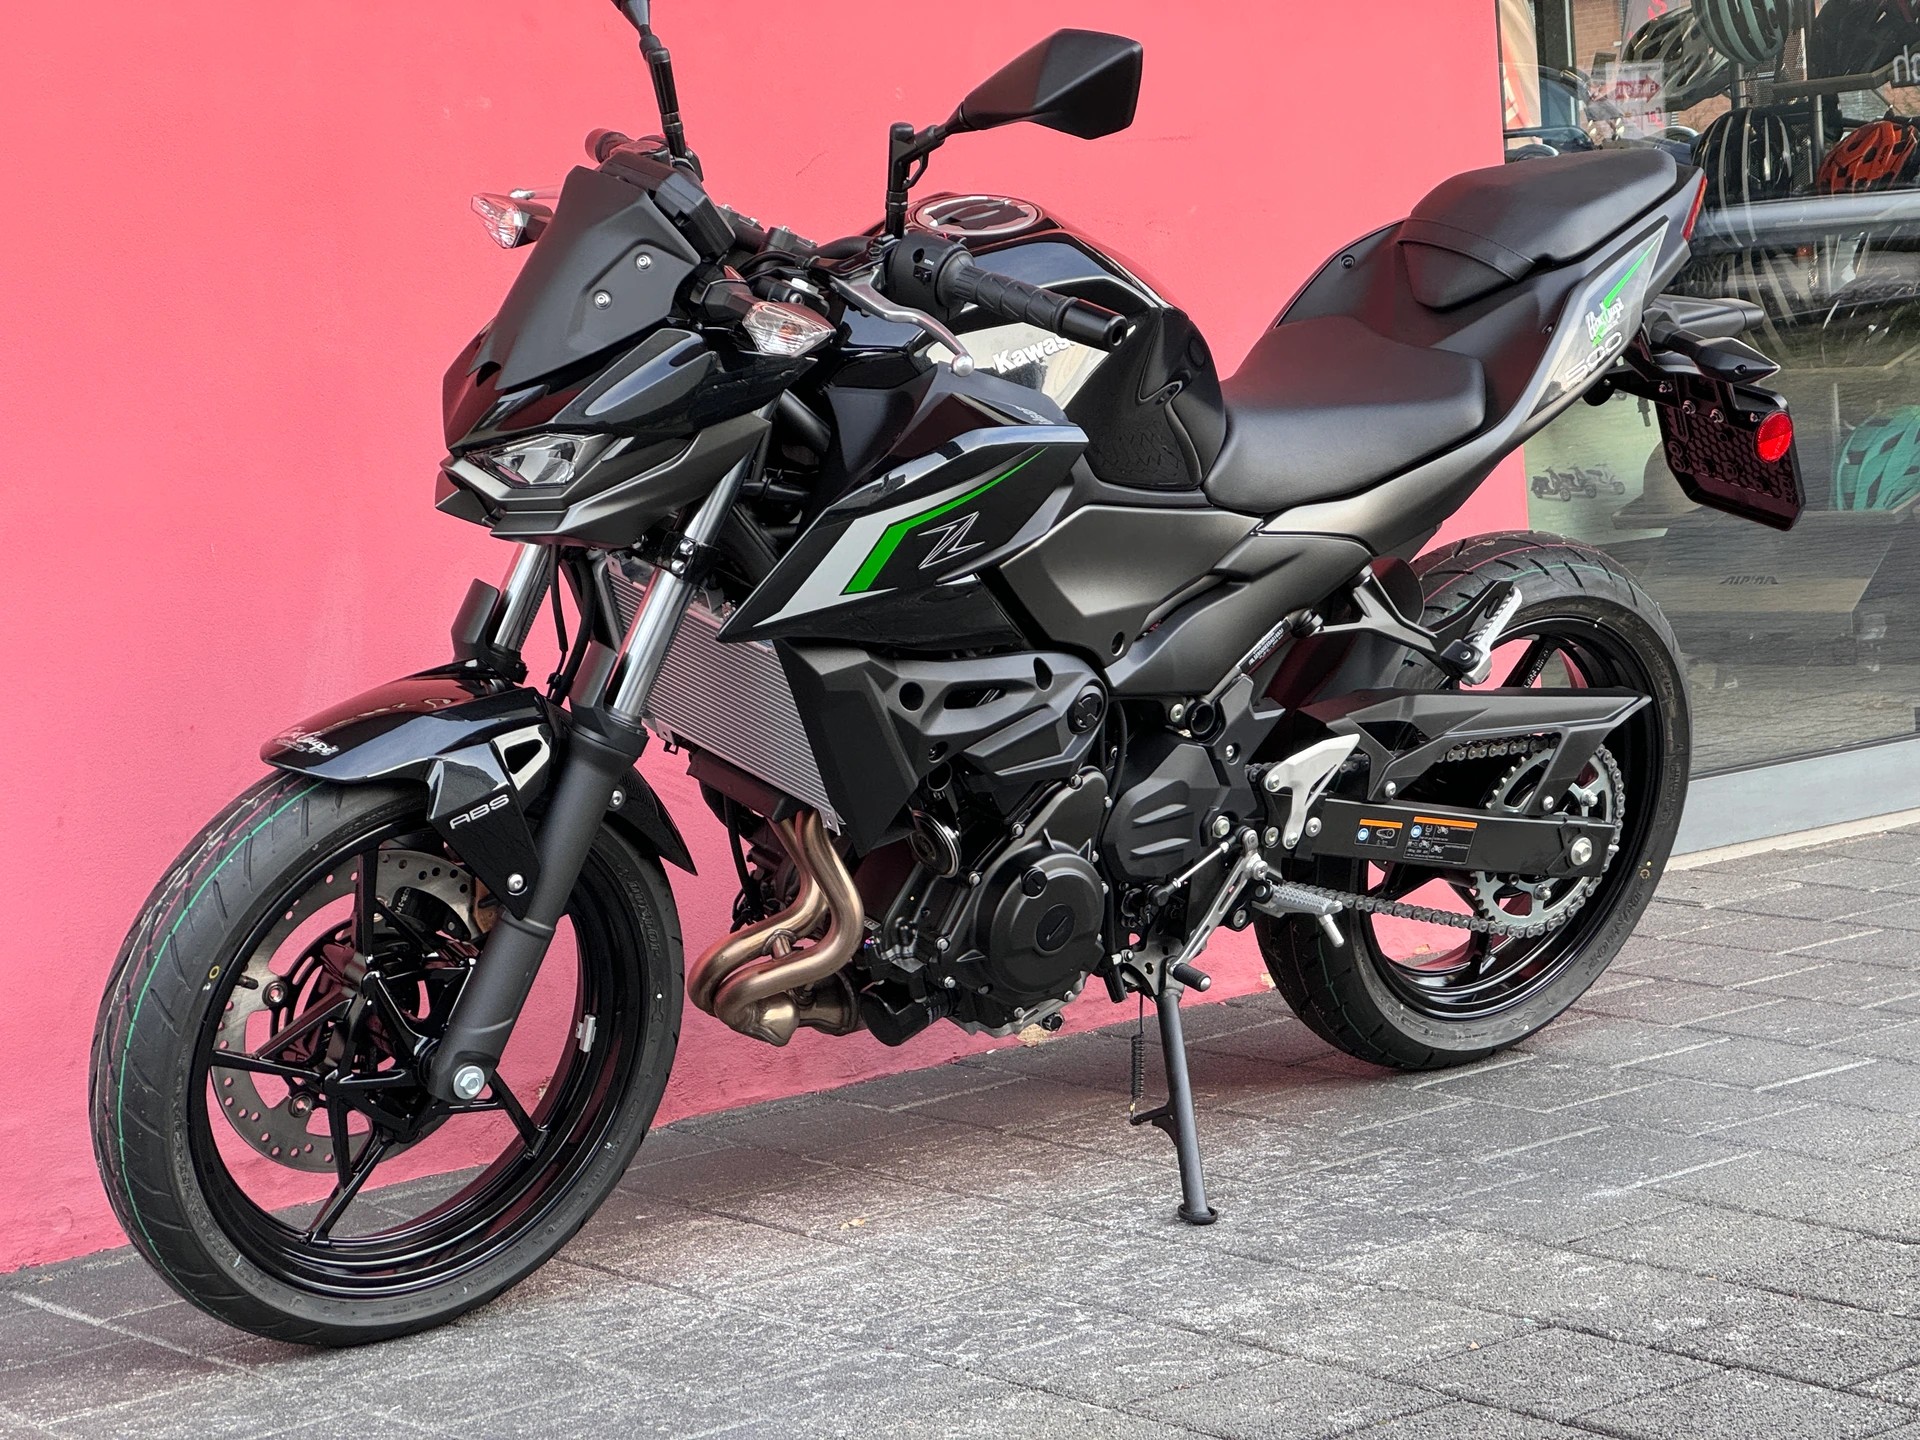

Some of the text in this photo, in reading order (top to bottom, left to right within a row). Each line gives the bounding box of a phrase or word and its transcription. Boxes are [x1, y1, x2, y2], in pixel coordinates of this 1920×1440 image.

[992, 336, 1074, 374] Kawas
[1561, 331, 1623, 391] 500
[917, 511, 986, 571] Z
[449, 793, 511, 831] ABS
